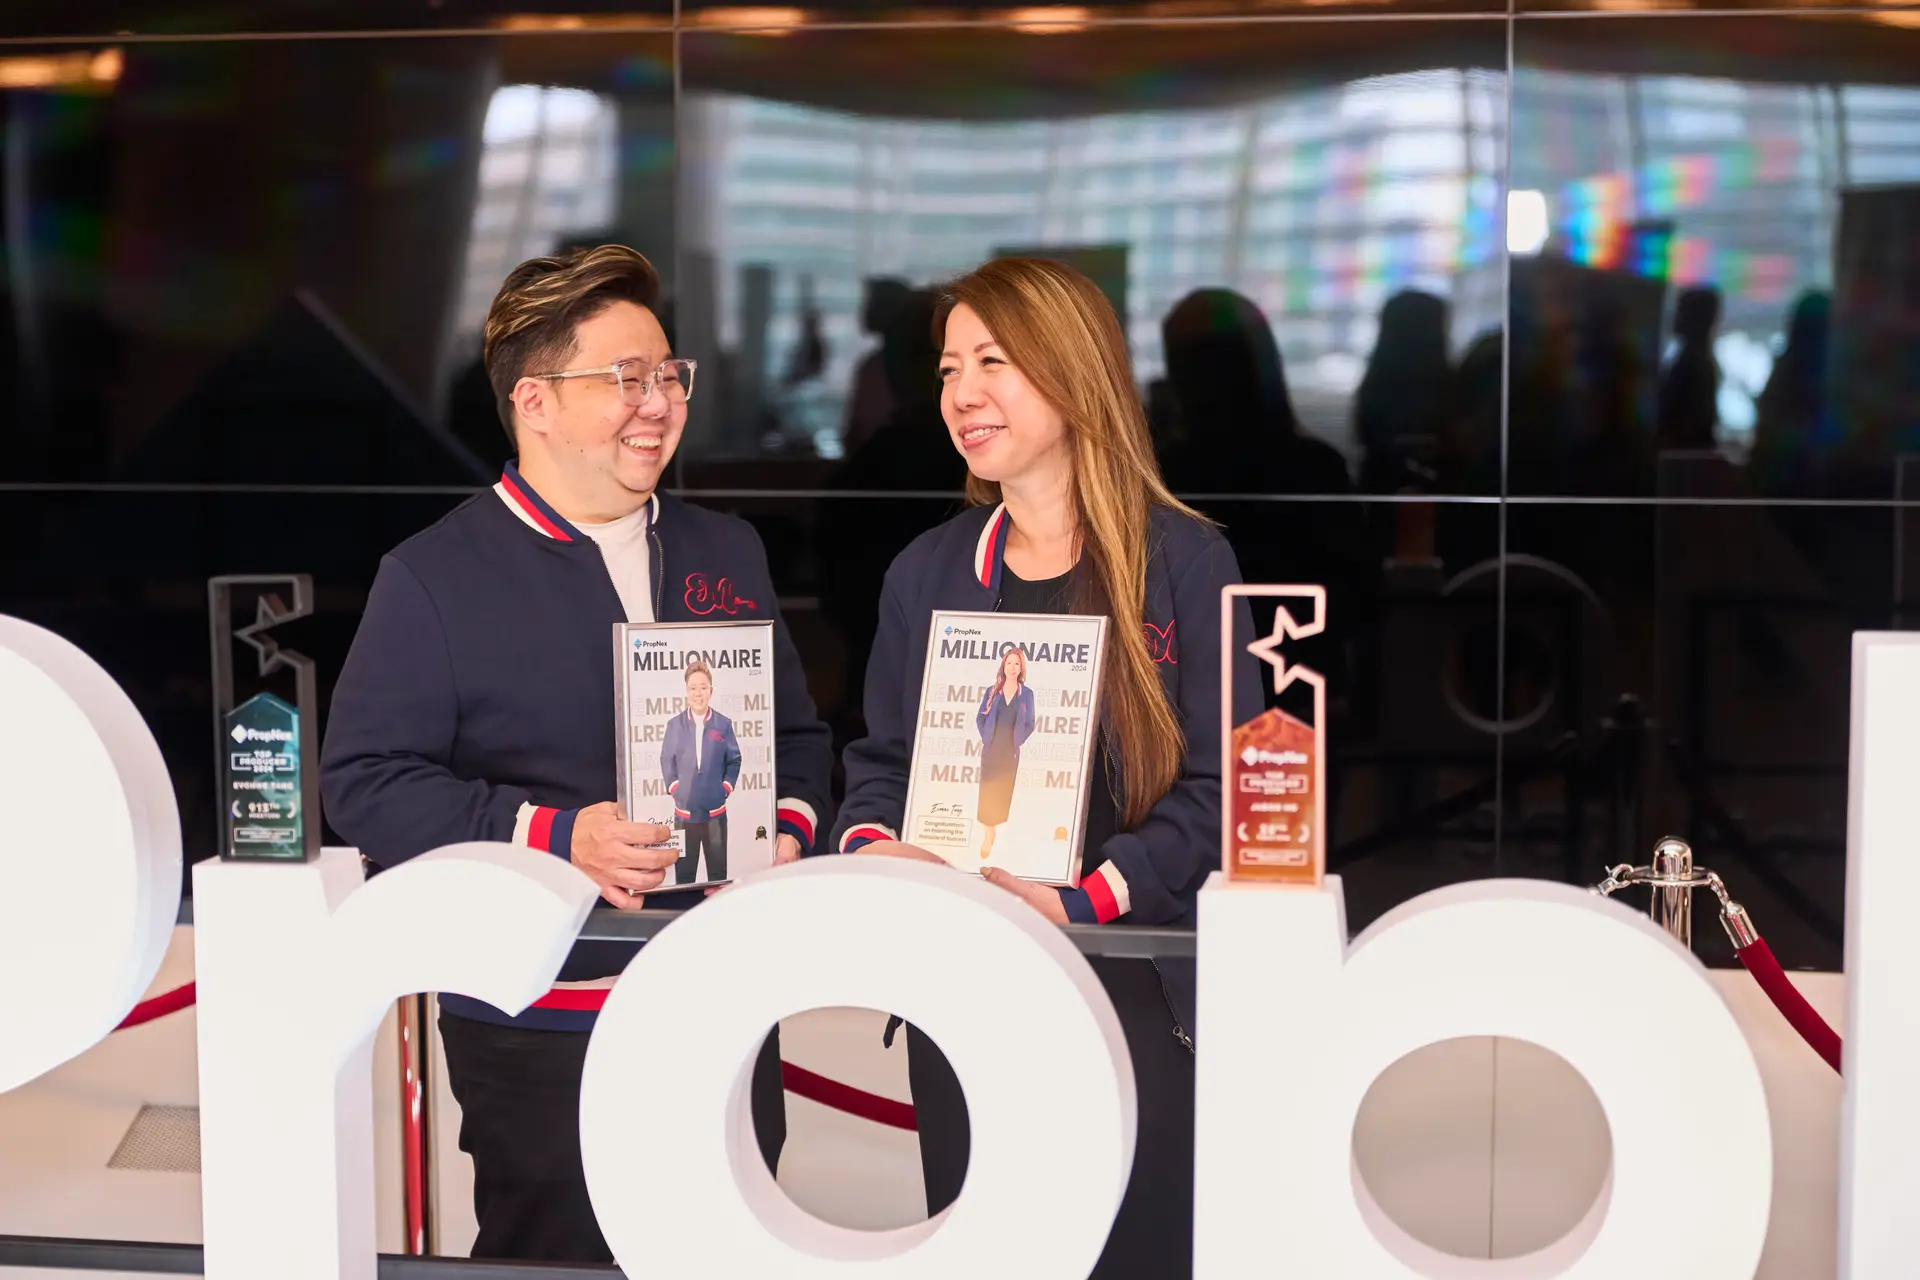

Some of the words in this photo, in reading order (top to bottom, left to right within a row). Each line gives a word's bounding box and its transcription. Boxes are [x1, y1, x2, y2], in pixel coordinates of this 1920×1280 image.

[953, 628, 982, 637] PropNex
[643, 640, 668, 649] PropNex
[940, 638, 1090, 664] MILLIONAIRE
[633, 648, 762, 672] MILLIONAIRE
[1071, 665, 1088, 673] 2024
[247, 728, 292, 743] PropNex
